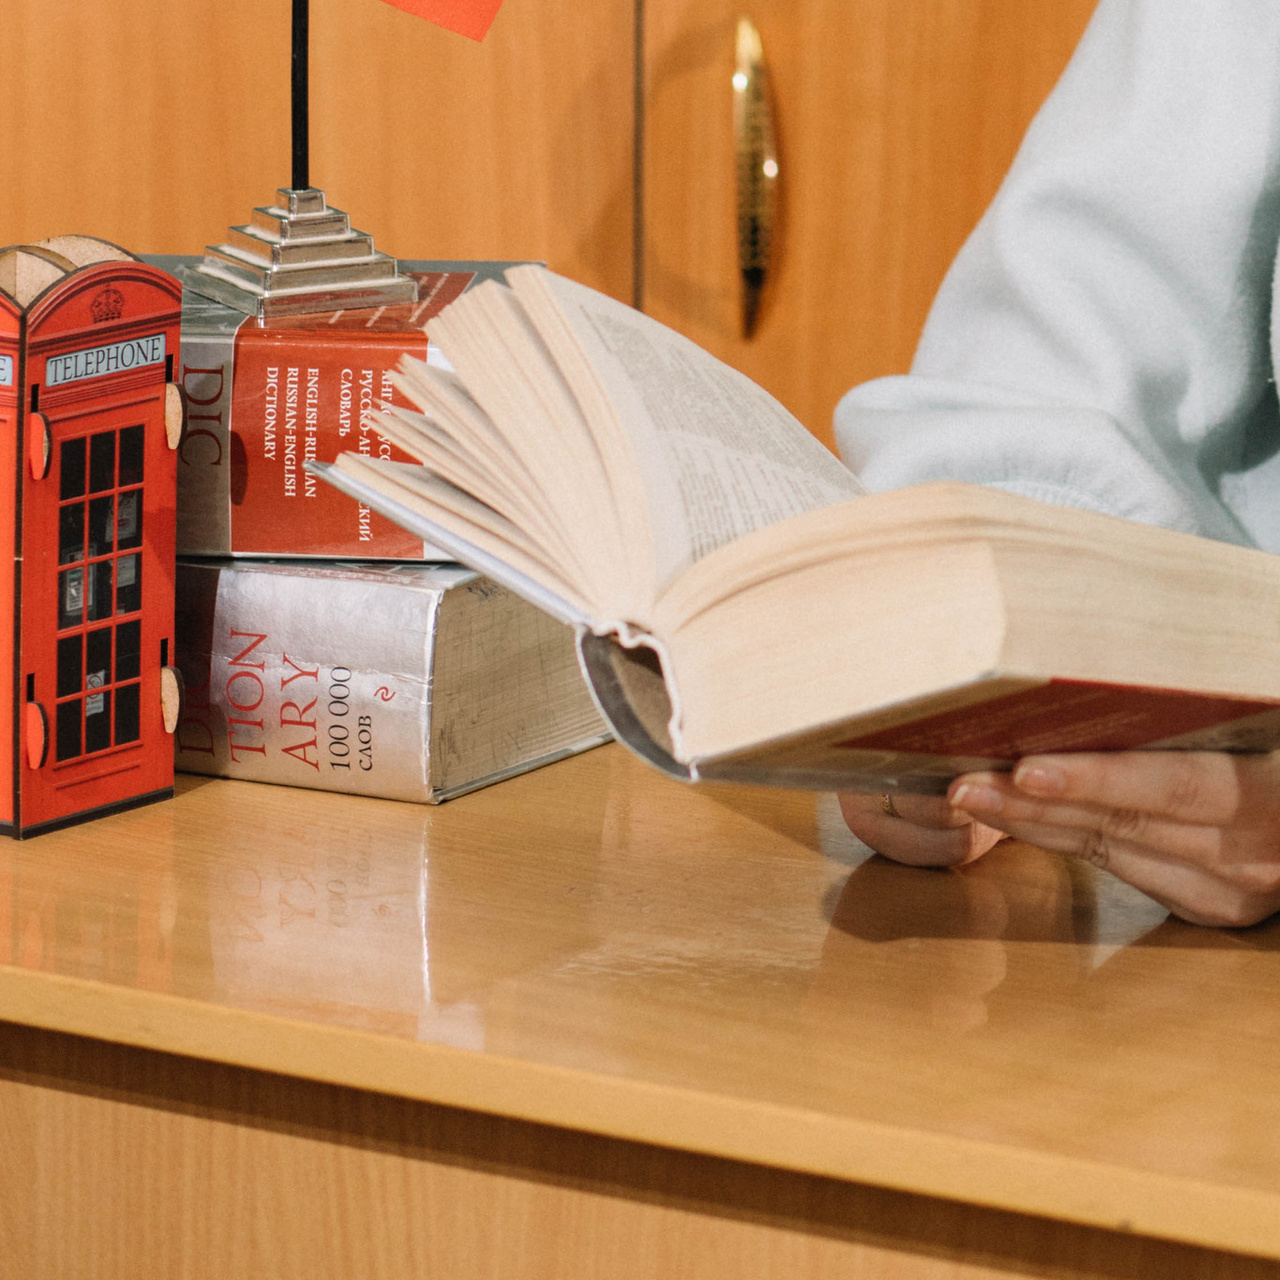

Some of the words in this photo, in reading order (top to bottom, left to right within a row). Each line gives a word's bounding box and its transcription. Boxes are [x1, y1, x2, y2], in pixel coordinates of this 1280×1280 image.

[51, 336, 161, 383] TELEPHONE
[181, 363, 224, 467] DIC
[263, 366, 279, 462] DICTIONARY
[339, 369, 353, 438] СЛОВАРЬ
[284, 367, 299, 498] RUSSIAN-ENGLISH
[304, 368, 319, 498] ENGLISH-RUSIAN
[226, 626, 268, 764] TION
[280, 651, 320, 772] ARY
